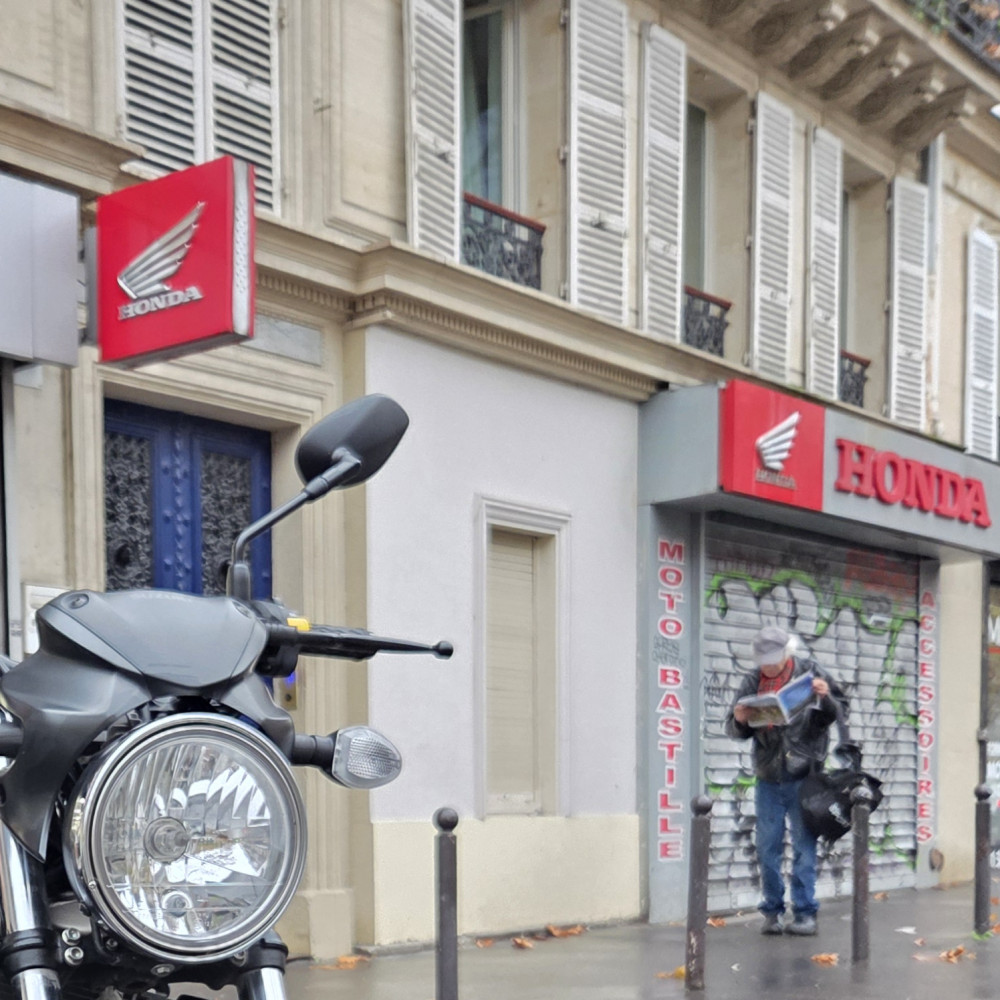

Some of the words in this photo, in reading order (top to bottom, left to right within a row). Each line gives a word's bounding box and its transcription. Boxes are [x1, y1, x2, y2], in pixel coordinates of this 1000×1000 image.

[118, 286, 203, 320] HONDA
[835, 438, 992, 528] HONDA
[657, 540, 685, 640] MOTO
[655, 664, 685, 862] BASTILLE
[917, 591, 936, 844] ACCESSOIRES
